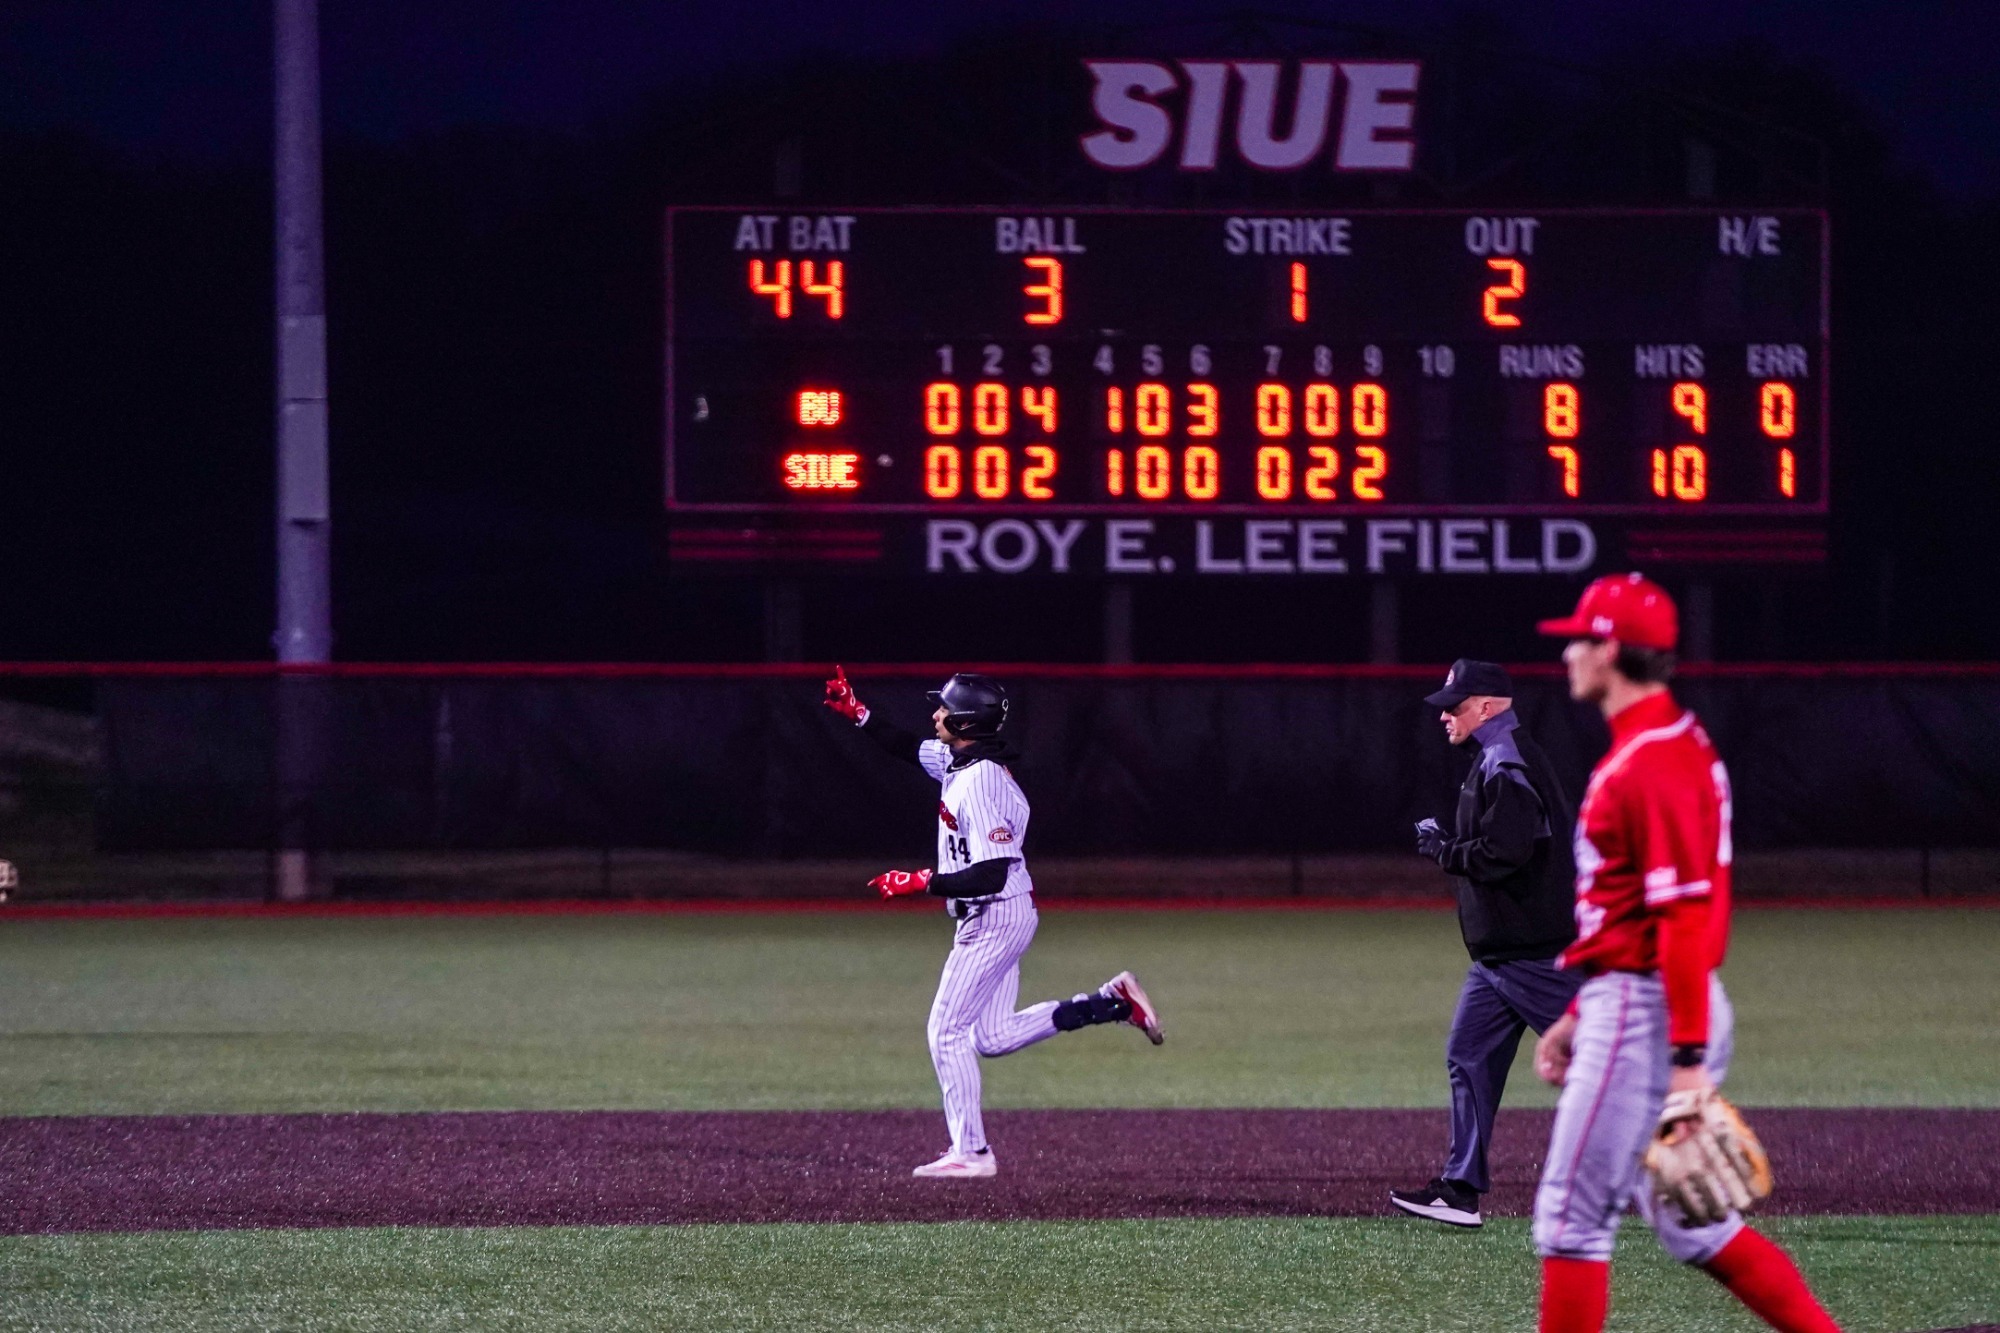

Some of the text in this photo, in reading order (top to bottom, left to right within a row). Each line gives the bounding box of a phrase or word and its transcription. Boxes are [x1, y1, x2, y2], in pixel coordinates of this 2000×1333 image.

[1082, 60, 1420, 170] SIUE
[735, 215, 857, 253] AT BAT
[997, 217, 1088, 255] BALL
[1226, 217, 1352, 256] STRIKE
[1466, 217, 1540, 256] OUT
[1719, 217, 1781, 257] H/E
[752, 259, 843, 319] 44
[1024, 257, 1062, 325] 3
[1290, 261, 1307, 323] 1
[1483, 259, 1524, 326] 2
[939, 344, 1457, 379] 1 2 3 4 5 6 7 8 9 10
[1500, 345, 1585, 379] RUNS
[1635, 345, 1706, 378] HITS
[1747, 345, 1809, 378] ERR
[798, 390, 841, 426] BU
[1544, 383, 1578, 438] 8
[1673, 382, 1706, 434] 9
[1761, 382, 1794, 437] 0
[784, 453, 859, 489] SIUE
[1547, 445, 1578, 497] 7
[1652, 445, 1706, 500] 10
[1780, 448, 1794, 497] 1
[928, 520, 1597, 574] ROY E. LEE FIELD
